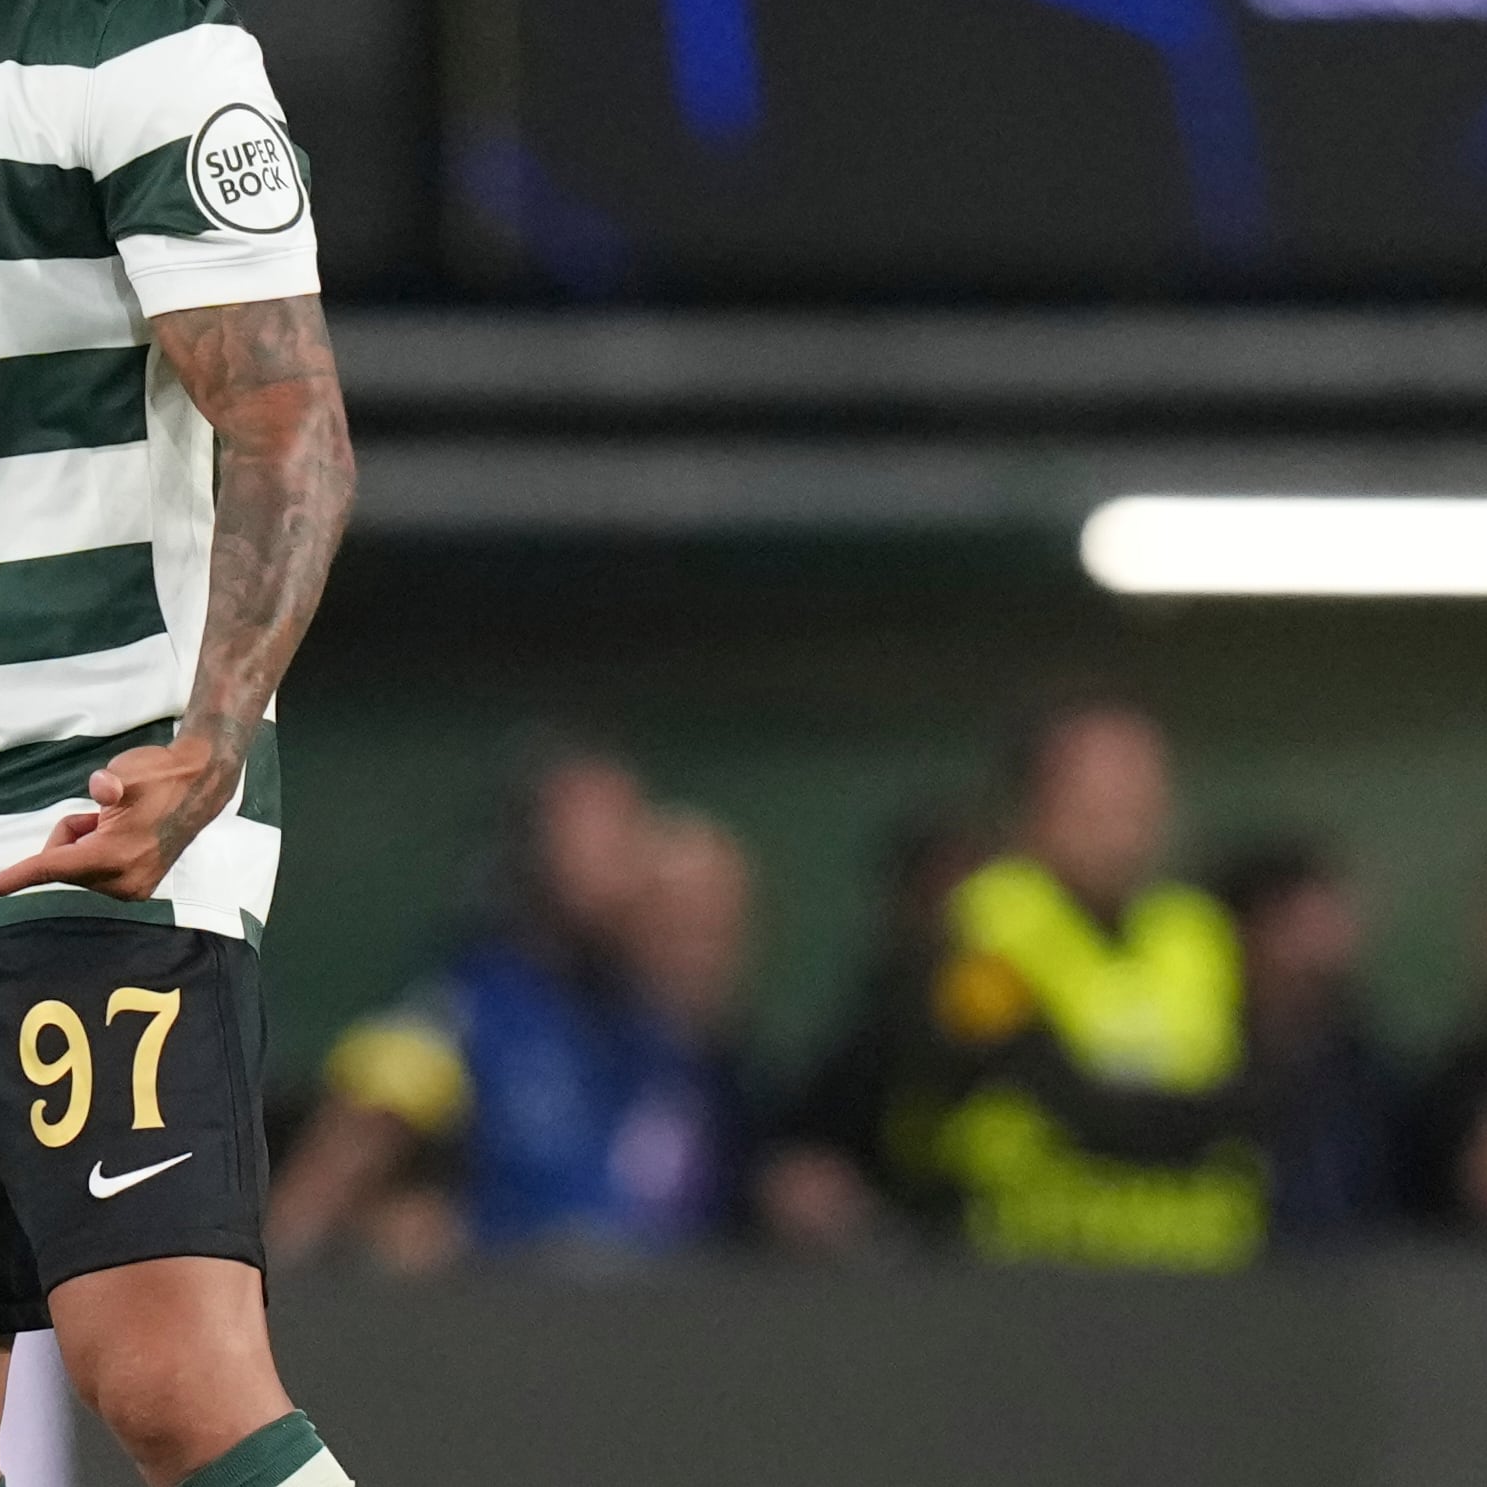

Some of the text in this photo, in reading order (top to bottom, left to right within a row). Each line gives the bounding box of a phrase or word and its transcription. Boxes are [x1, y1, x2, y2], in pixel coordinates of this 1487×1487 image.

[205, 138, 281, 179] SUPER
[218, 166, 291, 205] BOCK
[18, 987, 181, 1148] 97
